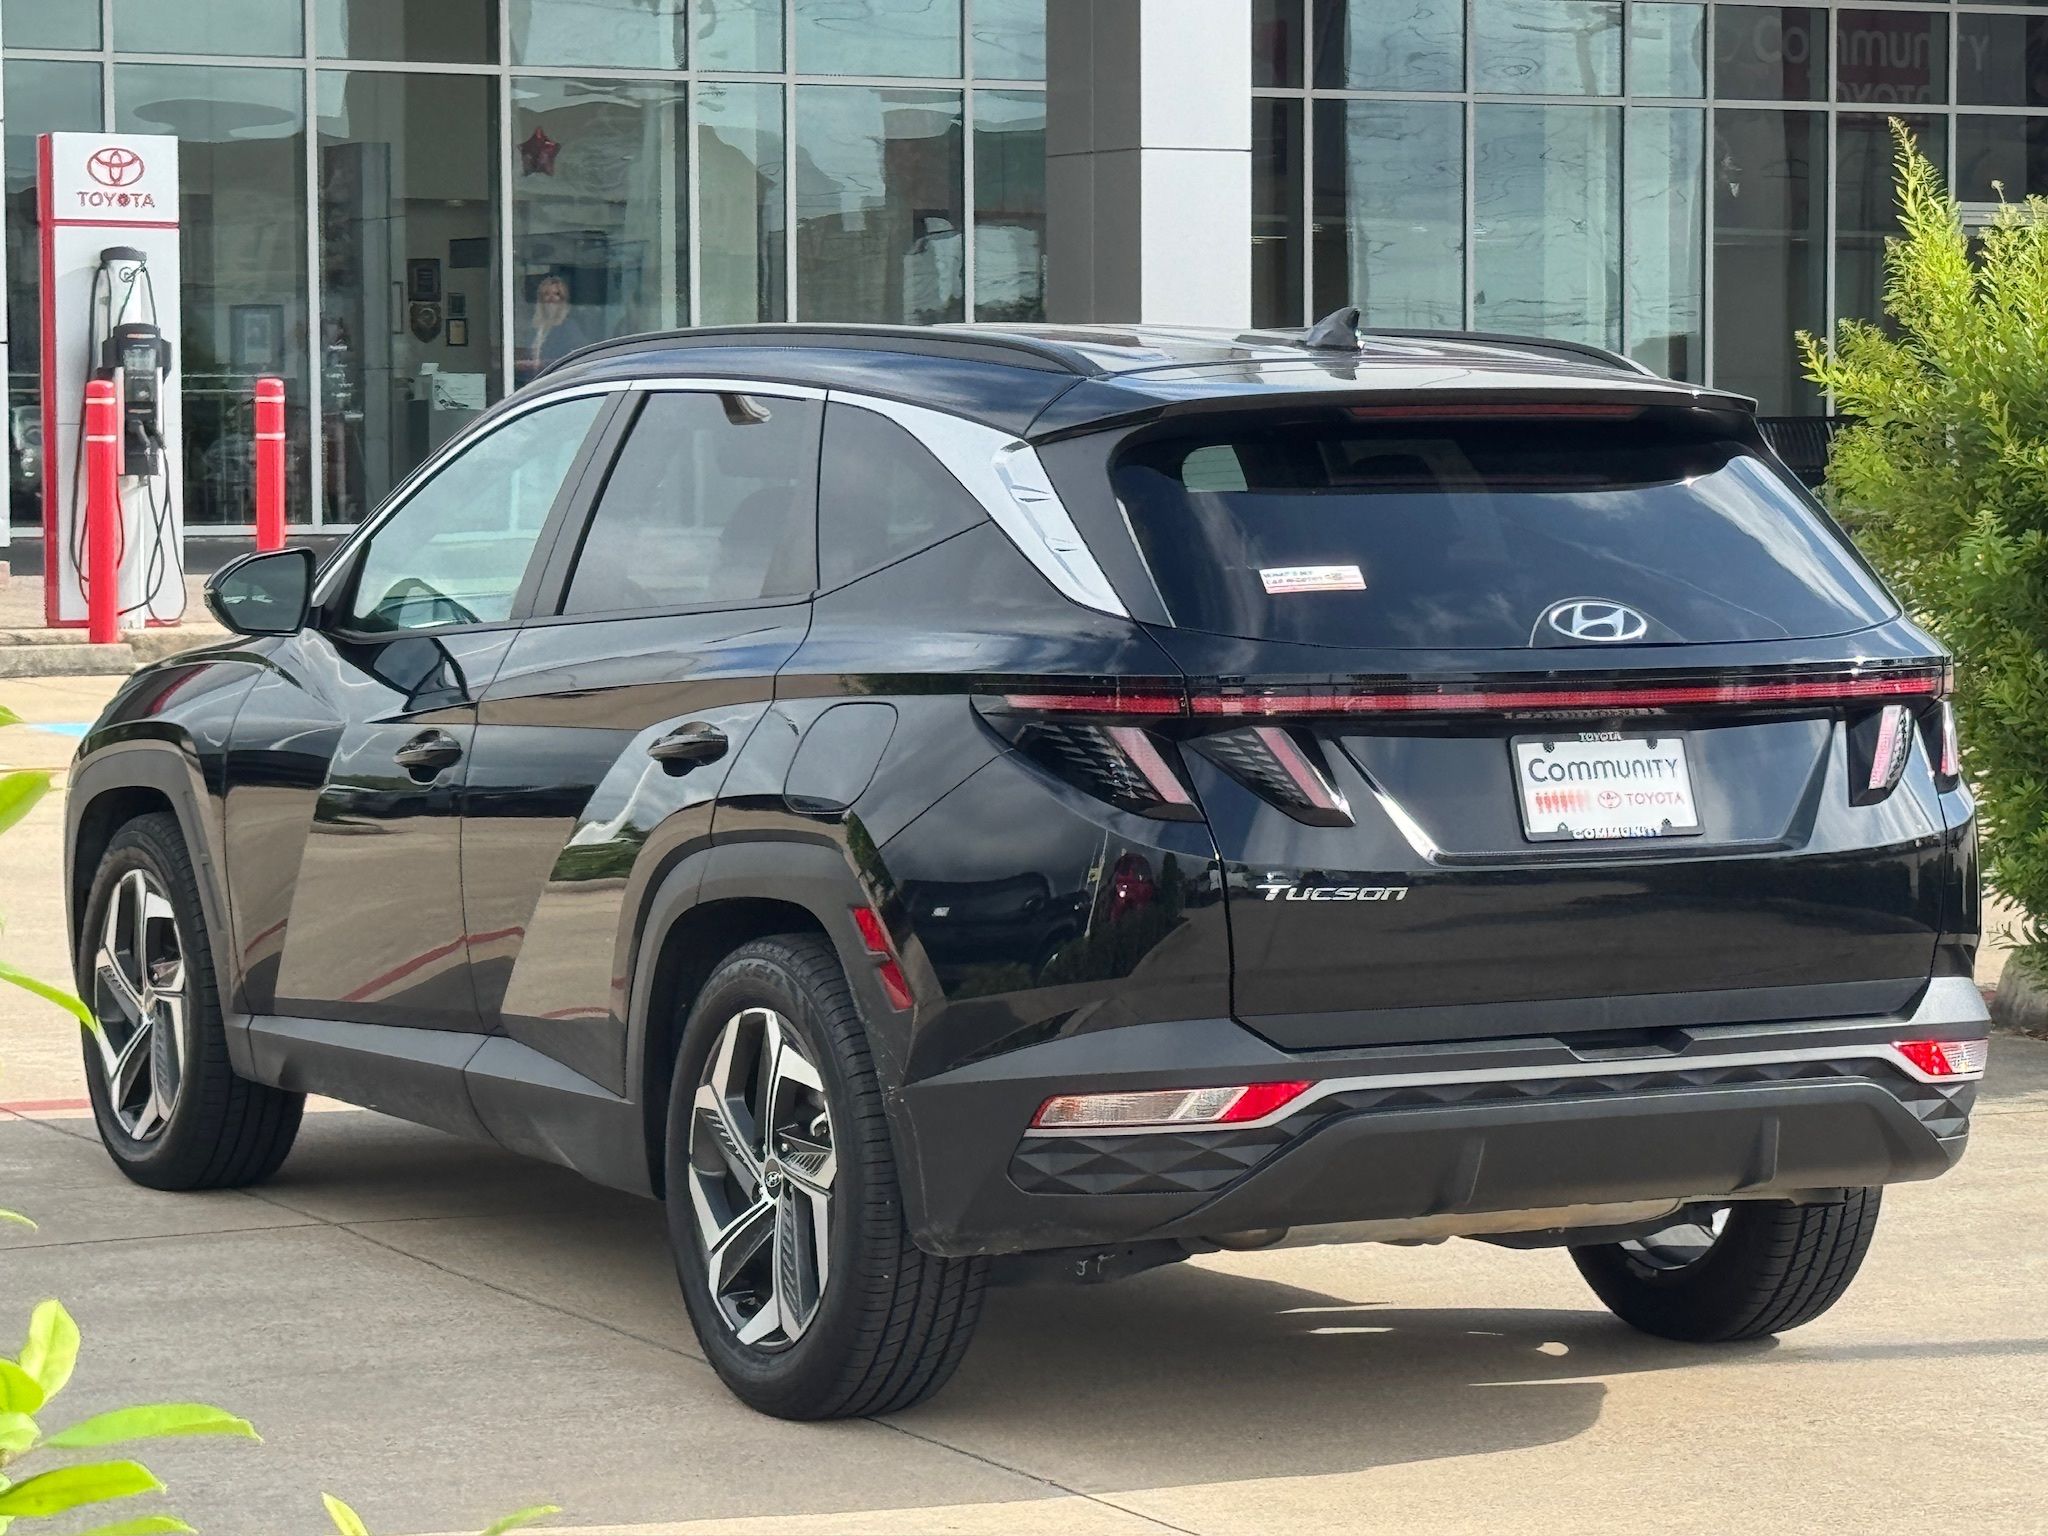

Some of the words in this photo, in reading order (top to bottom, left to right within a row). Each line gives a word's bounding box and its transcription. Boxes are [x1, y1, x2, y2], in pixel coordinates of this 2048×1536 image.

[76, 191, 155, 208] TOYOTA
[1578, 731, 1622, 742] TOYOTA
[1624, 791, 1685, 808] TOYOTA
[1256, 884, 1408, 901] Tucson
